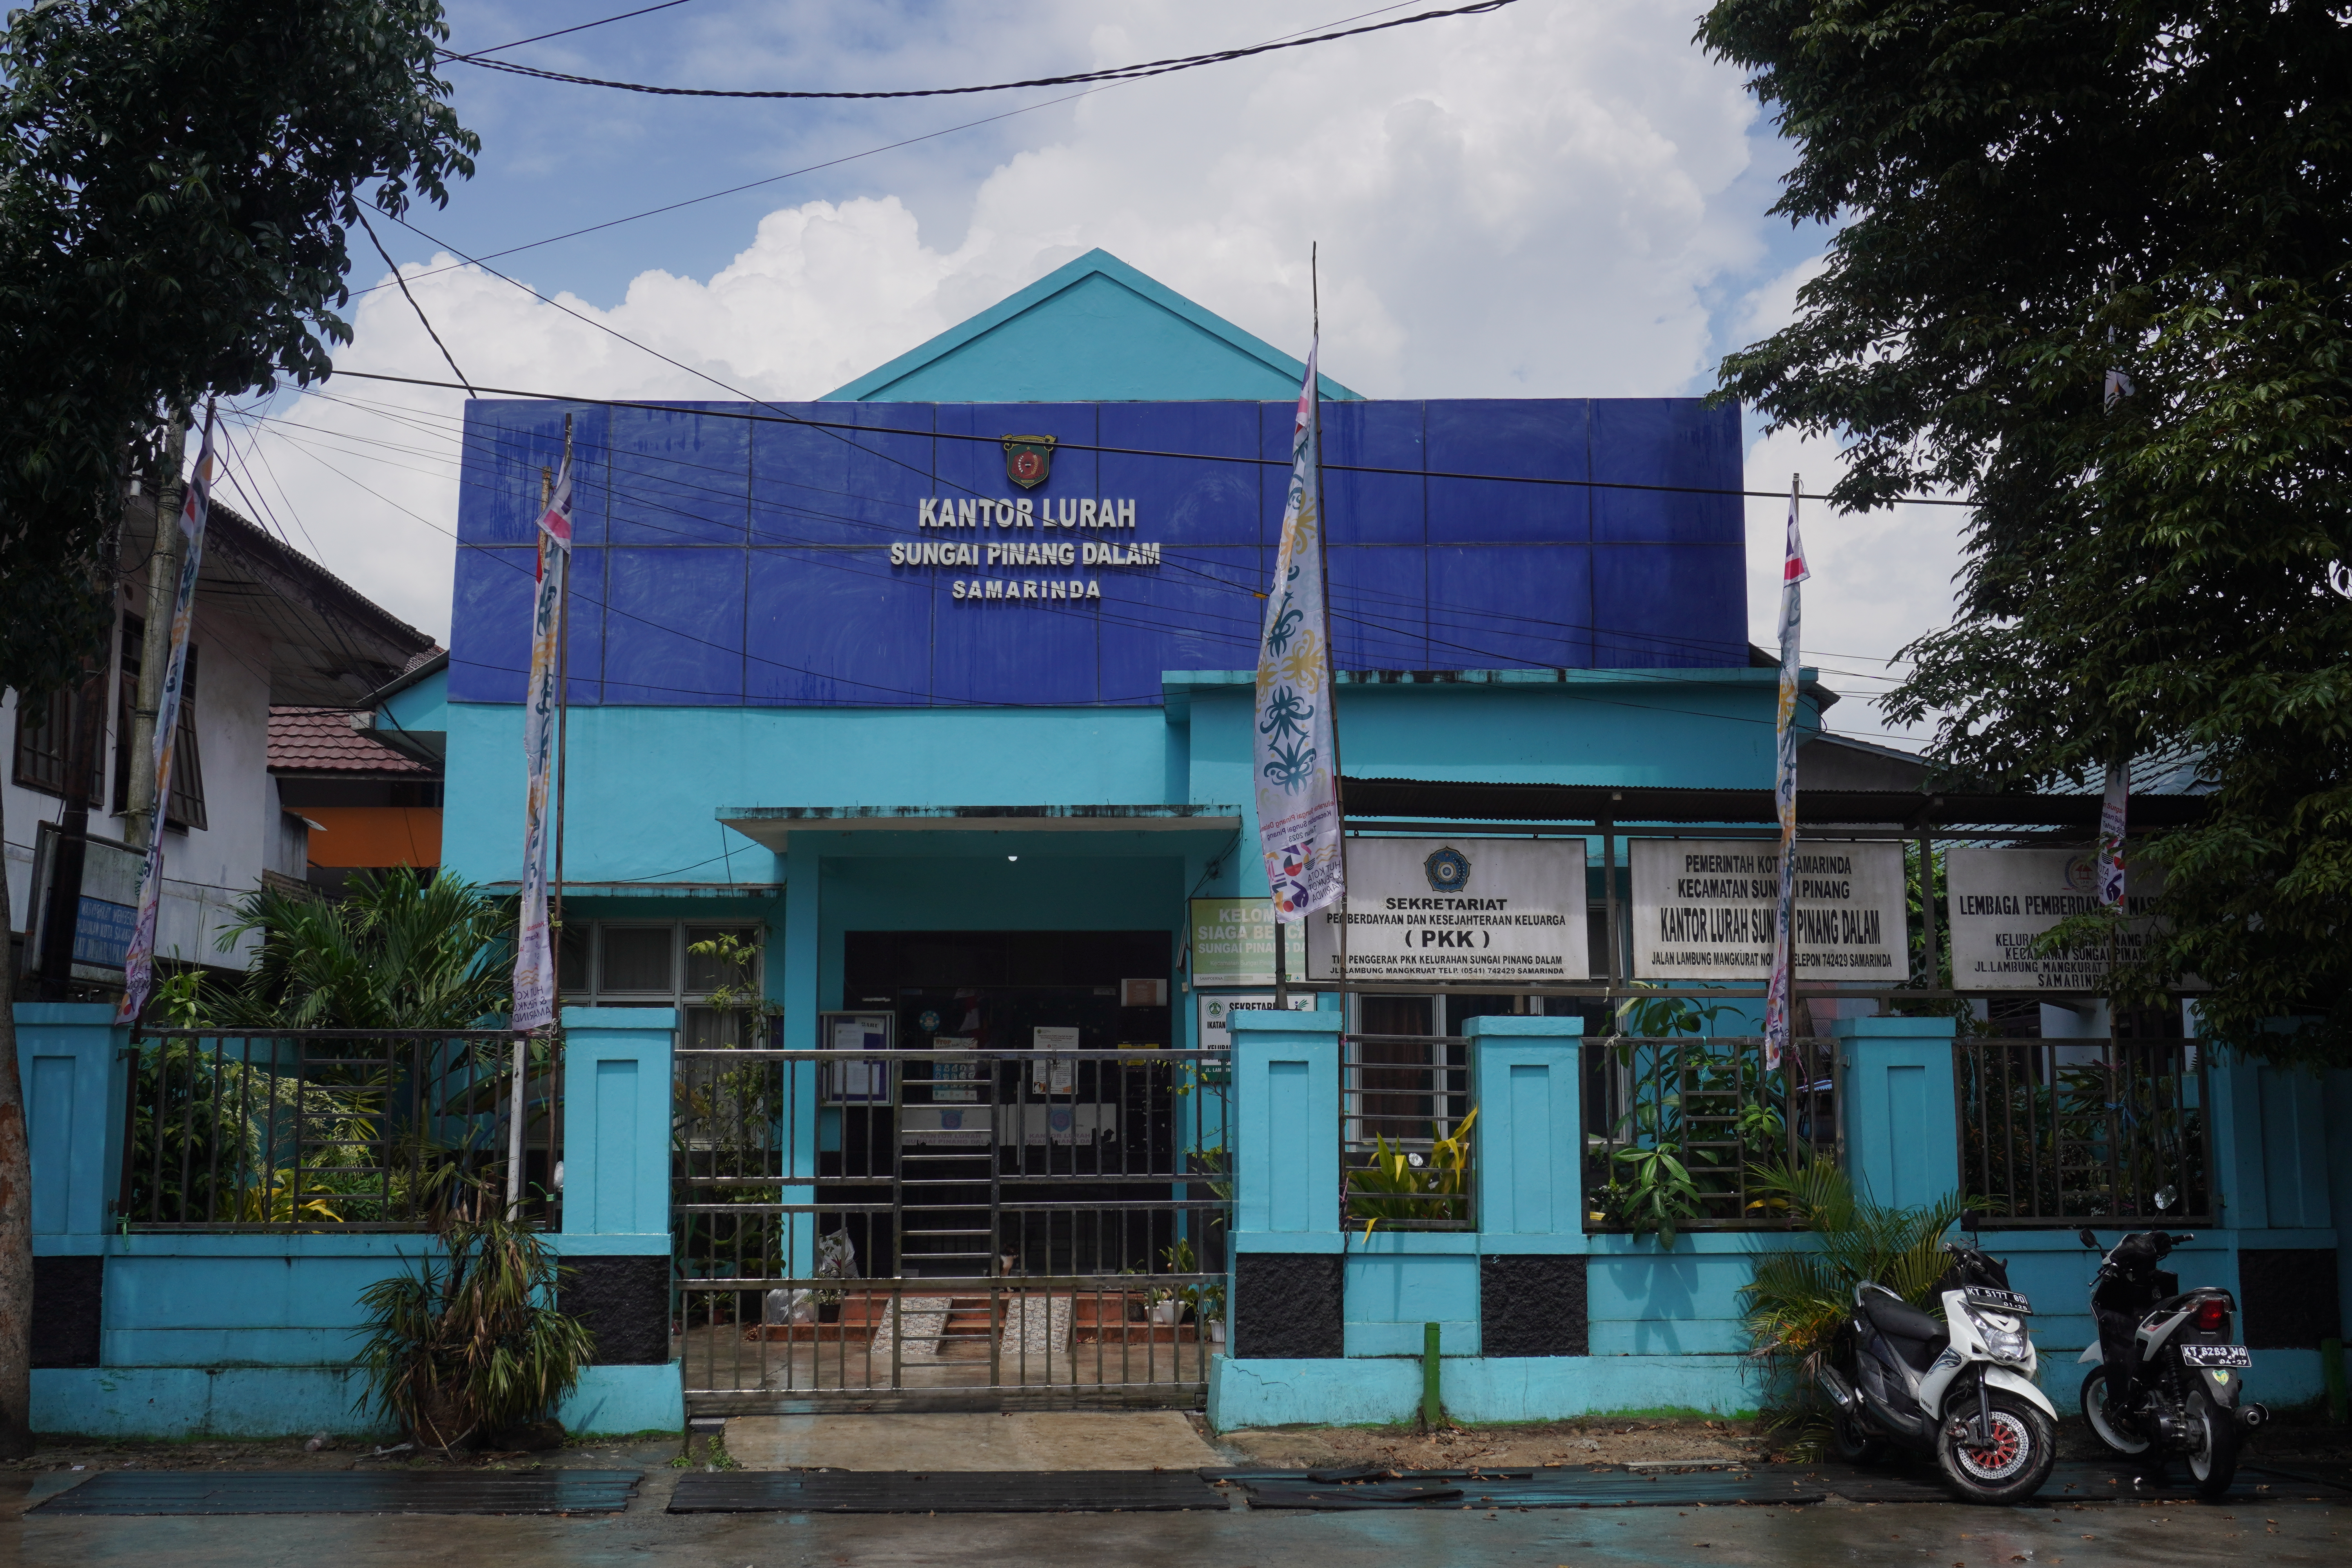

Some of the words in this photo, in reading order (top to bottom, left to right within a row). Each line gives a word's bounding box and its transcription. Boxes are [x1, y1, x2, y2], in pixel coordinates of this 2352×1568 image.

[919, 498, 1034, 528] KANTOR
[1043, 498, 1135, 528] LURAH
[890, 542, 978, 565] SUNGAI
[987, 542, 1075, 565] PINANG
[1083, 543, 1160, 565] DALAM
[952, 580, 1101, 599] SAMARINDA
[1686, 855, 1754, 873] PEMERINTAH
[1758, 856, 1780, 873] KOT
[1796, 856, 1852, 874] AMARINDA
[1678, 878, 1748, 898] KECAMATAN
[1751, 880, 1799, 898] SUNI
[1803, 880, 1850, 899] PINANG
[1386, 898, 1507, 911] SEKRETARIAT
[1960, 896, 2020, 915] LEMBAGA
[2025, 896, 2104, 916] PEMBERDAY
[1220, 908, 1276, 923] KELOM
[1407, 915, 1428, 925] DAN
[1430, 915, 1512, 925] KESEJAHTERAAN
[1515, 915, 1566, 926] KELUARGA
[1661, 907, 1707, 942] KANTOR
[1710, 908, 1749, 943] LURAH
[1751, 908, 1776, 943] SUN
[1797, 909, 1839, 944] PINANG
[1842, 910, 1880, 944] DALAM
[1198, 926, 1248, 940] SIAGA
[1253, 926, 1305, 939] BECA
[1422, 930, 1474, 947] PKK
[1198, 943, 1242, 953] SUNGAI
[1246, 942, 1290, 953] PINAG
[1996, 934, 2039, 946] KELURA
[2103, 934, 2141, 947] PNANG
[1332, 955, 1342, 964] TI
[1349, 955, 1397, 964] PENGGERAK
[1401, 955, 1417, 964] PKK
[1420, 955, 1467, 964] KELURAHAN
[1470, 955, 1500, 964] SUNGAI
[1503, 956, 1533, 964] PINANG
[1536, 956, 1562, 964] DALAM
[1652, 952, 1674, 965] JALAN
[1677, 952, 1711, 965] LAMBUNG
[1713, 952, 1759, 966] MANGKURAT
[1795, 953, 1821, 967] ELEPON
[1822, 954, 1848, 967] 742429
[1850, 954, 1892, 967] SAMARINDA
[2005, 947, 2068, 960] KECAAAN
[2073, 948, 2110, 960] SUNGAI
[2116, 948, 2147, 961] PINAN
[1975, 962, 2038, 973] JL.LAMBUNG
[2043, 962, 2102, 973] MANGKURAT
[2038, 974, 2100, 987] SAMARIN
[1229, 1002, 1275, 1011] SEKRETARI
[1967, 1288, 1980, 1296] KT
[1985, 1290, 2007, 1299] 5177
[2184, 1347, 2197, 1356] KT
[2201, 1347, 2228, 1356] 6263
[1920, 1397, 1932, 1410] YAMAHA
